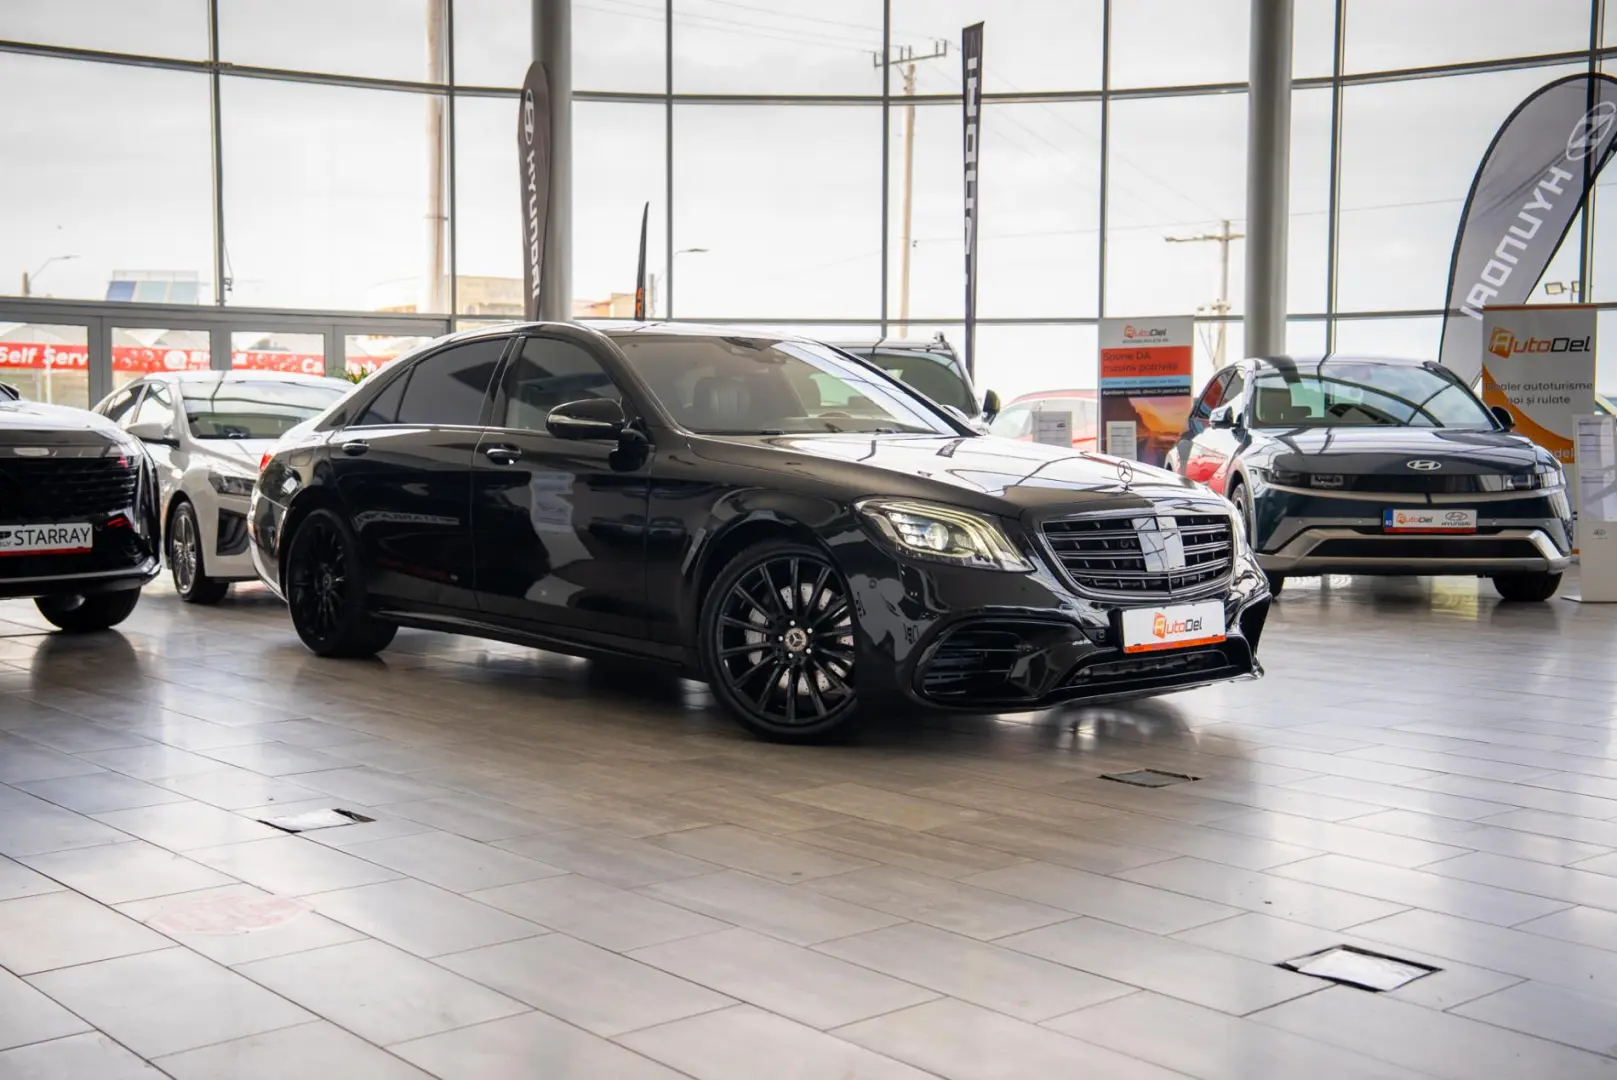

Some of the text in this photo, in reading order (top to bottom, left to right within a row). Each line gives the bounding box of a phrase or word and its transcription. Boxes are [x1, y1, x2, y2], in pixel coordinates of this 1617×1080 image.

[527, 149, 541, 300] HYUNDAI
[1488, 328, 1591, 357] AutoDel
[0, 346, 37, 364] Self
[1523, 381, 1593, 391] autoturisme
[1537, 394, 1571, 405] rulate
[13, 527, 91, 546] STARRAY
[1153, 612, 1203, 637] AutoDel
